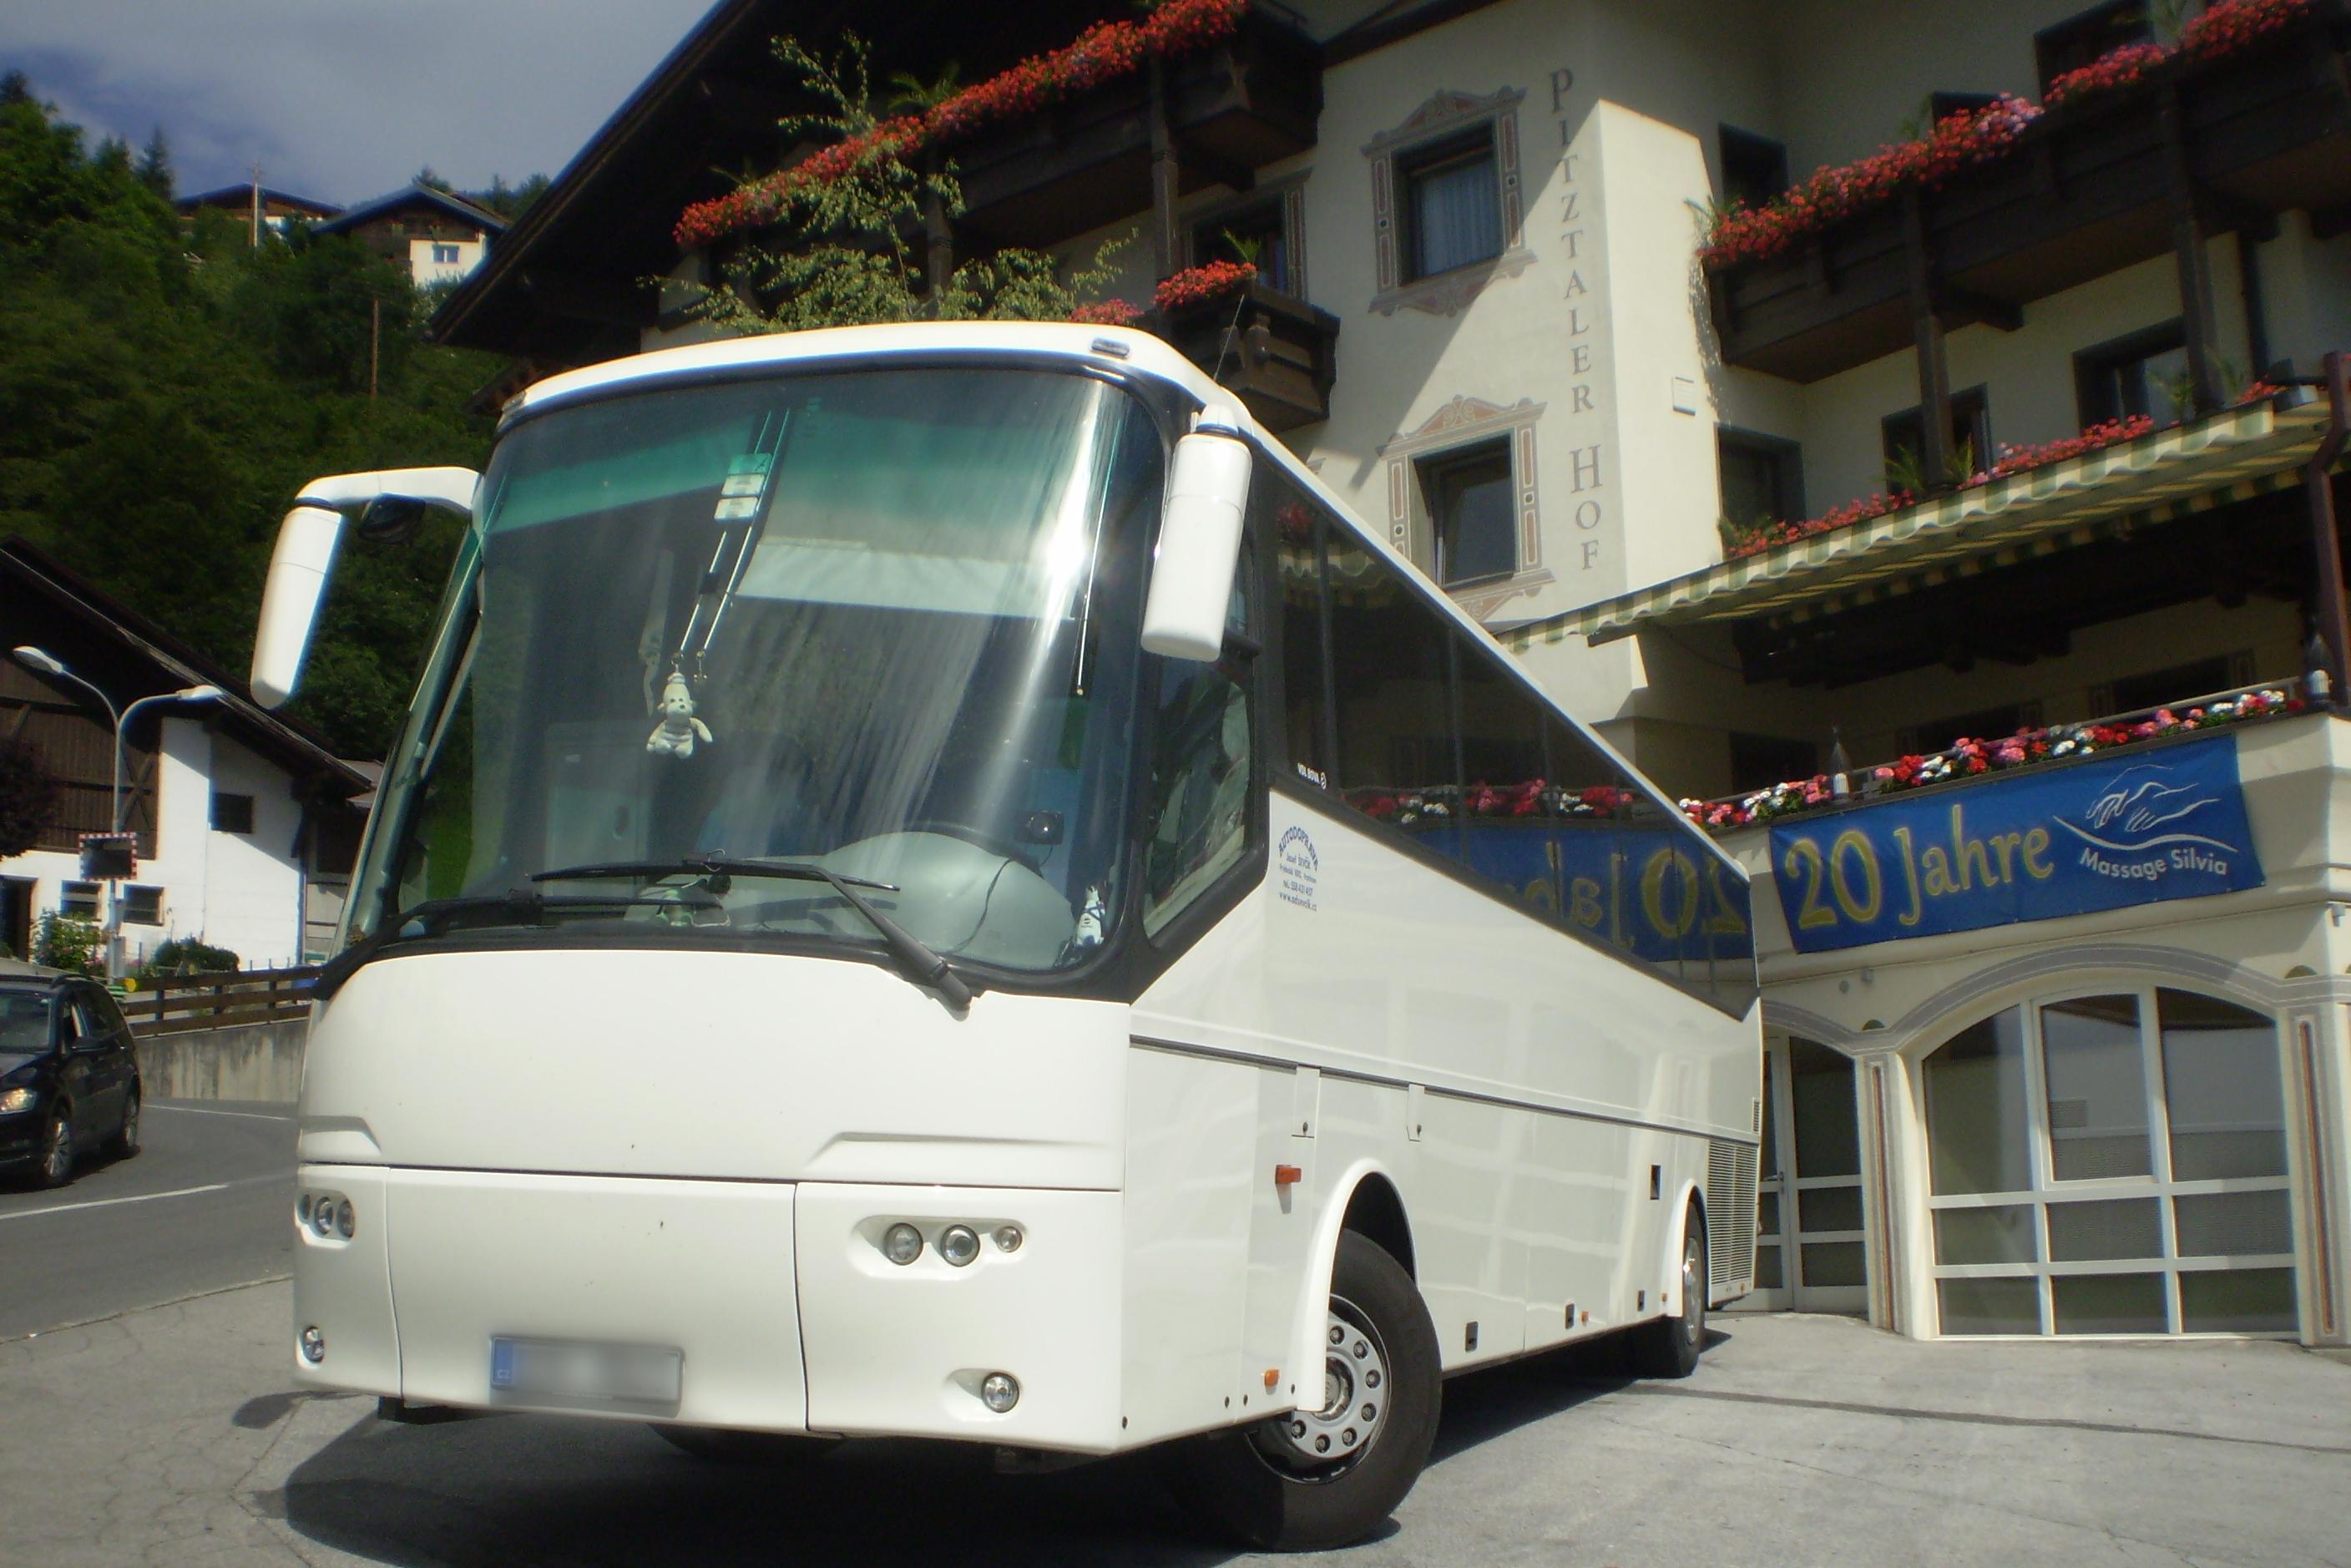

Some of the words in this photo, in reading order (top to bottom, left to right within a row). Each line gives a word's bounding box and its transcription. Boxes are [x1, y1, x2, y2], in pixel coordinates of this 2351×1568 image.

[1549, 67, 1595, 414] PITZTALER
[1570, 444, 1602, 570] HOF
[1785, 829, 1883, 930] 20
[1893, 803, 2055, 927] Jahre
[2079, 847, 2167, 881] Massage
[2171, 847, 2227, 875] Silvia
[497, 1368, 510, 1379] CZ
